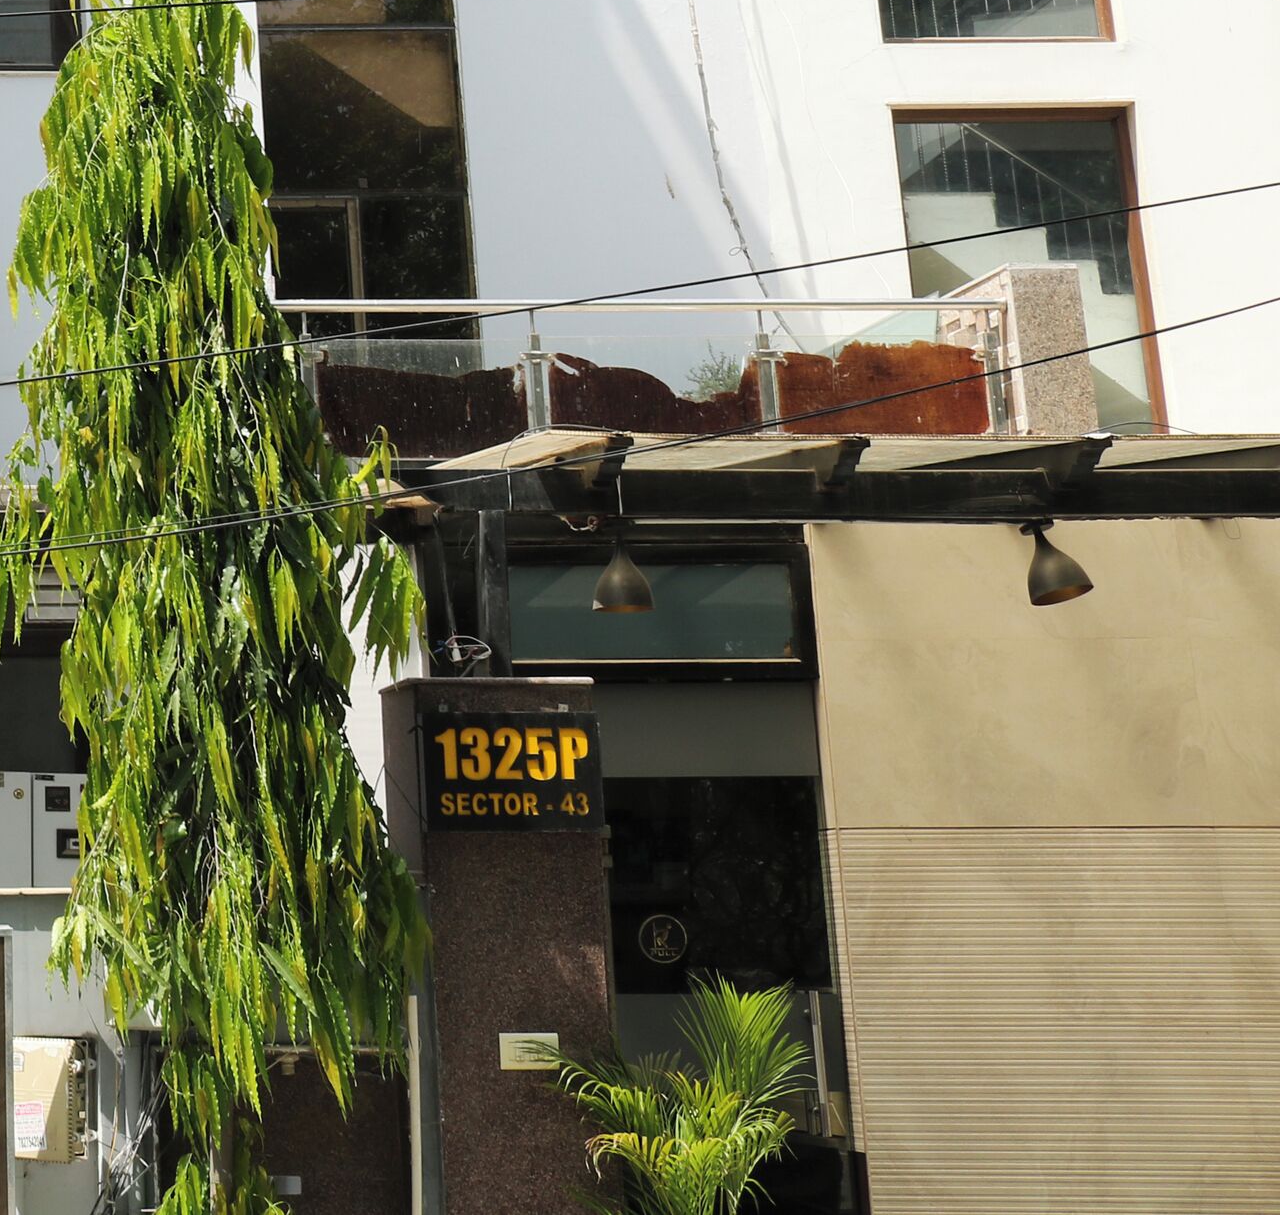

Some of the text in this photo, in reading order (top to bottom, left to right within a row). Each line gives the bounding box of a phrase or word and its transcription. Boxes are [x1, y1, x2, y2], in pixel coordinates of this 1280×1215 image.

[435, 727, 589, 781] 1325P
[441, 792, 539, 816] SECTOR
[560, 792, 590, 816] 43
